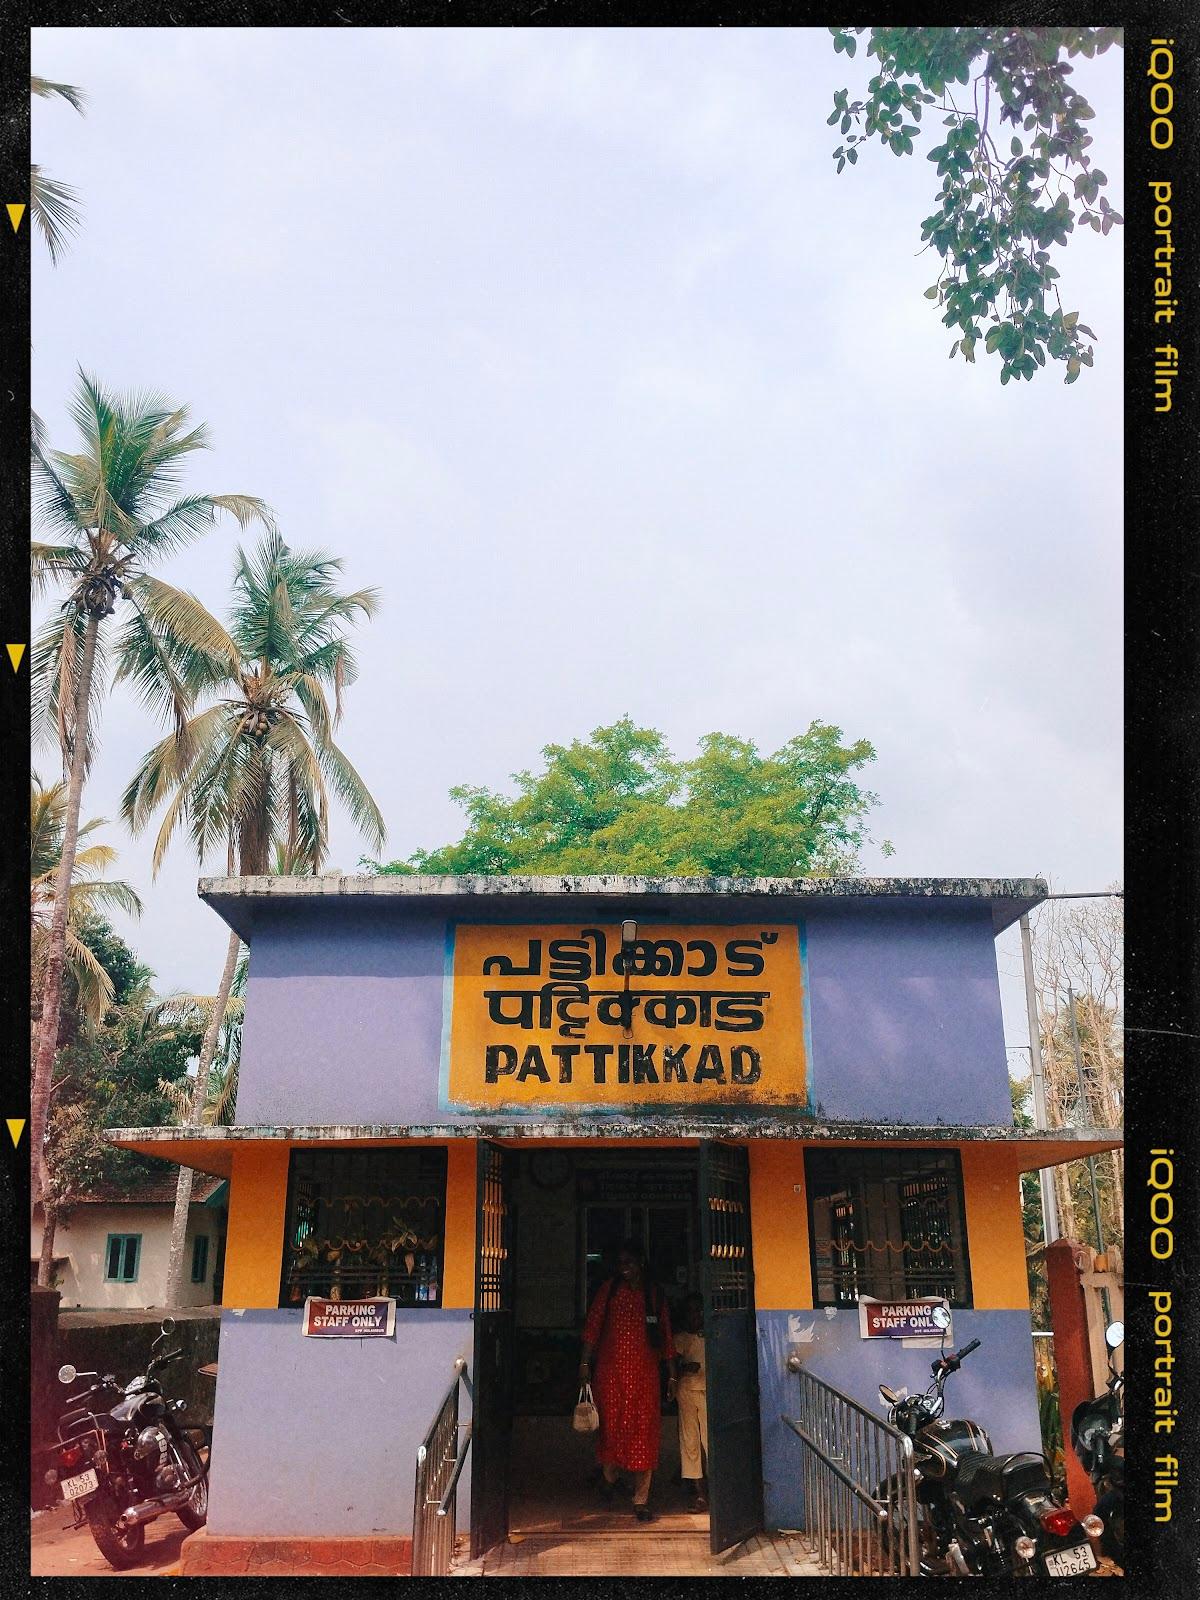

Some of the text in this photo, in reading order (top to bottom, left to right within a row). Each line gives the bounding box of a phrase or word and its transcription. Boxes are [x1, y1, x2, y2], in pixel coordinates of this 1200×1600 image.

[485, 1044, 762, 1084] PATTIKKAD
[325, 1305, 376, 1316] PARKING
[881, 1305, 931, 1317] PARKING
[313, 1316, 382, 1327] STAFF ONLY
[872, 1316, 936, 1328] STAFF ONL
[68, 1474, 90, 1488] KL 53
[1053, 1546, 1087, 1565] KL 53
